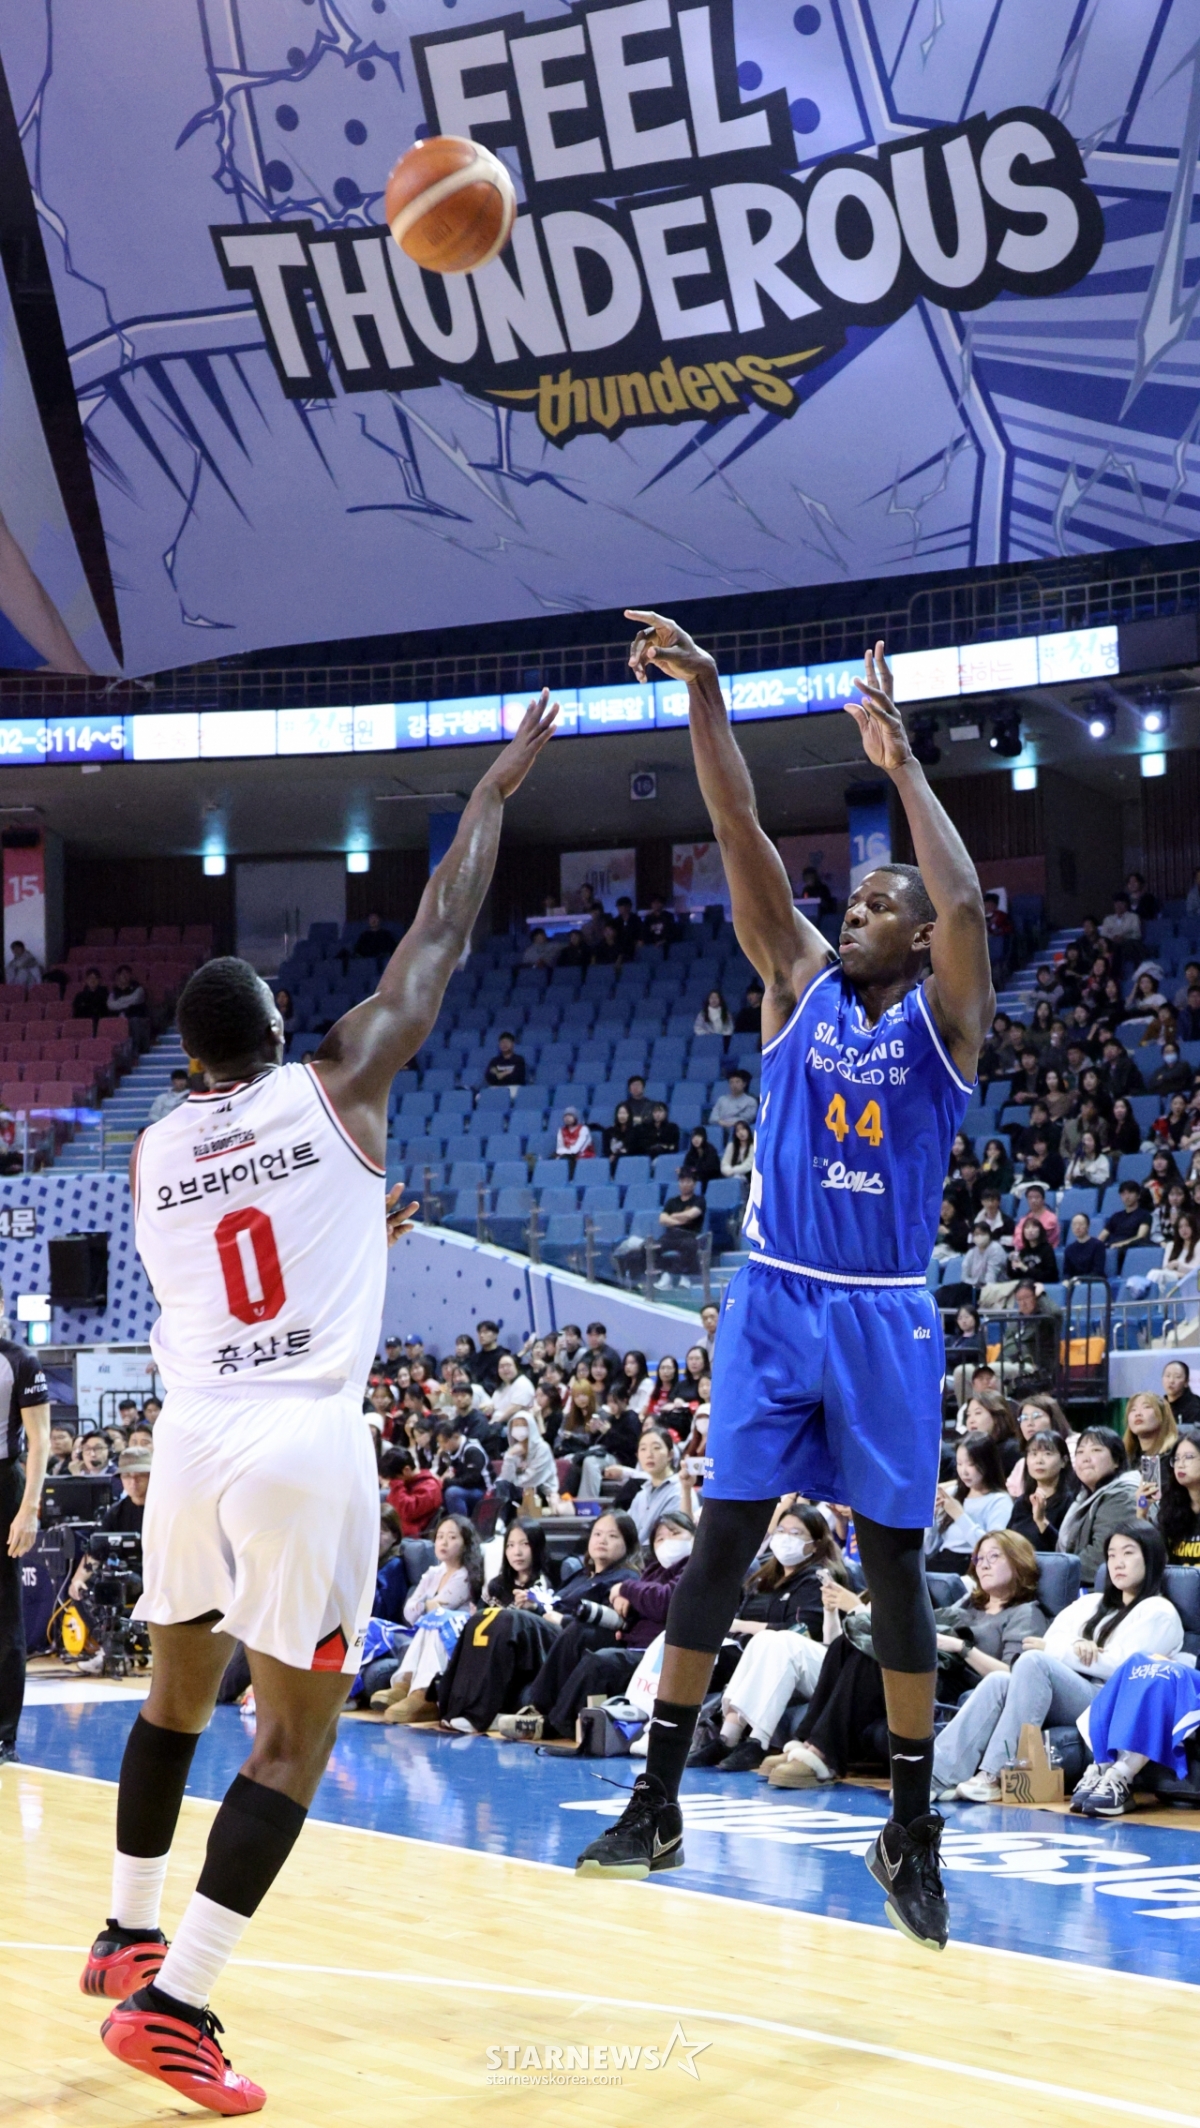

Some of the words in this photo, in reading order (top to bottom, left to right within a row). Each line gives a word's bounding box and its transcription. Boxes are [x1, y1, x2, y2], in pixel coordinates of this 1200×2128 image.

[424, 0, 772, 183] FEEL
[220, 121, 1080, 379] THUNDEROUS
[484, 346, 824, 438] thunders
[853, 832, 887, 862] 16
[9, 875, 40, 902] 15
[805, 1046, 835, 1073] Neo
[836, 1060, 885, 1086] QLED
[888, 1066, 911, 1086] 8K
[825, 1093, 884, 1147] 44
[157, 1141, 320, 1211] 오브라이언트
[214, 1206, 287, 1325] 0
[472, 1607, 502, 1647] 2
